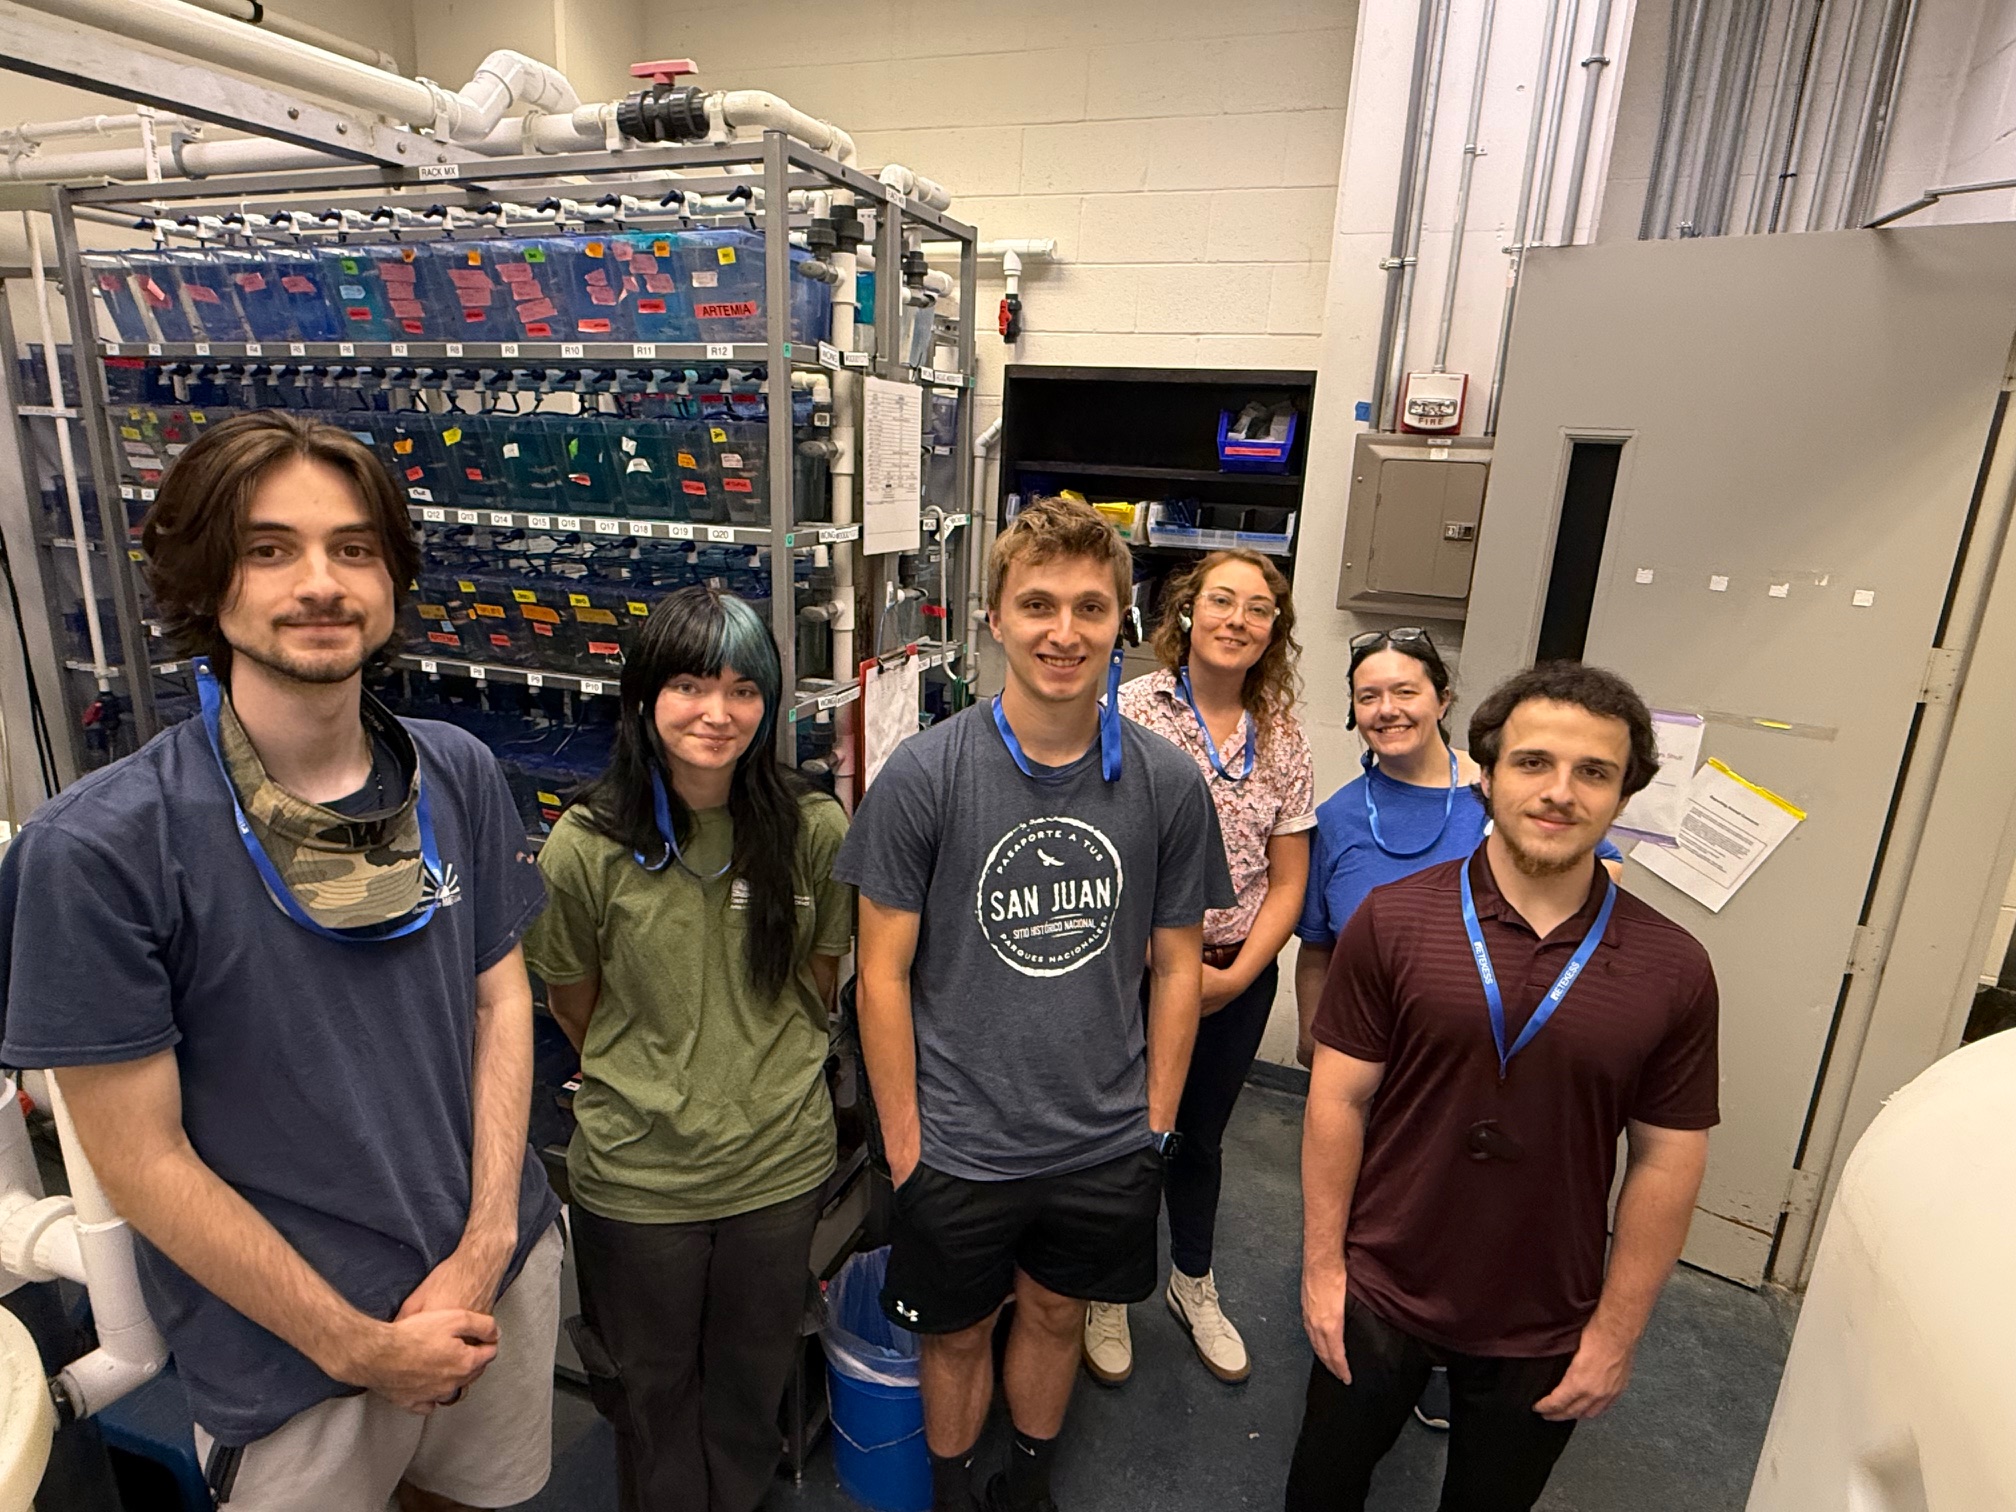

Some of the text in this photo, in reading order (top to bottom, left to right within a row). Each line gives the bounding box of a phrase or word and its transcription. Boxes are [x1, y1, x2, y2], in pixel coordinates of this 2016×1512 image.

[421, 166, 456, 177] RACK MX
[702, 303, 752, 317] ARTEMIA
[395, 345, 405, 354] R7
[450, 345, 460, 355] R8
[505, 345, 516, 355] R9
[564, 346, 580, 356] R10
[636, 346, 652, 356] R11
[711, 346, 728, 357] R12
[1417, 417, 1444, 426] FIRE
[426, 510, 440, 519] Q12
[460, 512, 475, 522] Q13
[493, 515, 508, 524] Q14
[531, 517, 547, 527] Q15
[560, 518, 576, 528] Q16
[599, 522, 615, 532] Q17
[633, 524, 649, 534] Q18
[672, 527, 689, 536] Q19
[712, 530, 729, 540] Q20
[425, 662, 434, 671] P7
[531, 676, 541, 685] P9
[585, 682, 600, 692] P10
[790, 710, 796, 720] P
[996, 830, 1104, 875] PASAPORTE A TUS
[990, 877, 1111, 921] SAN JUAN
[1012, 927, 1030, 940] SITIO
[1064, 918, 1097, 931] NACIONAL
[1000, 919, 1107, 963] PARQUES NACIONALES
